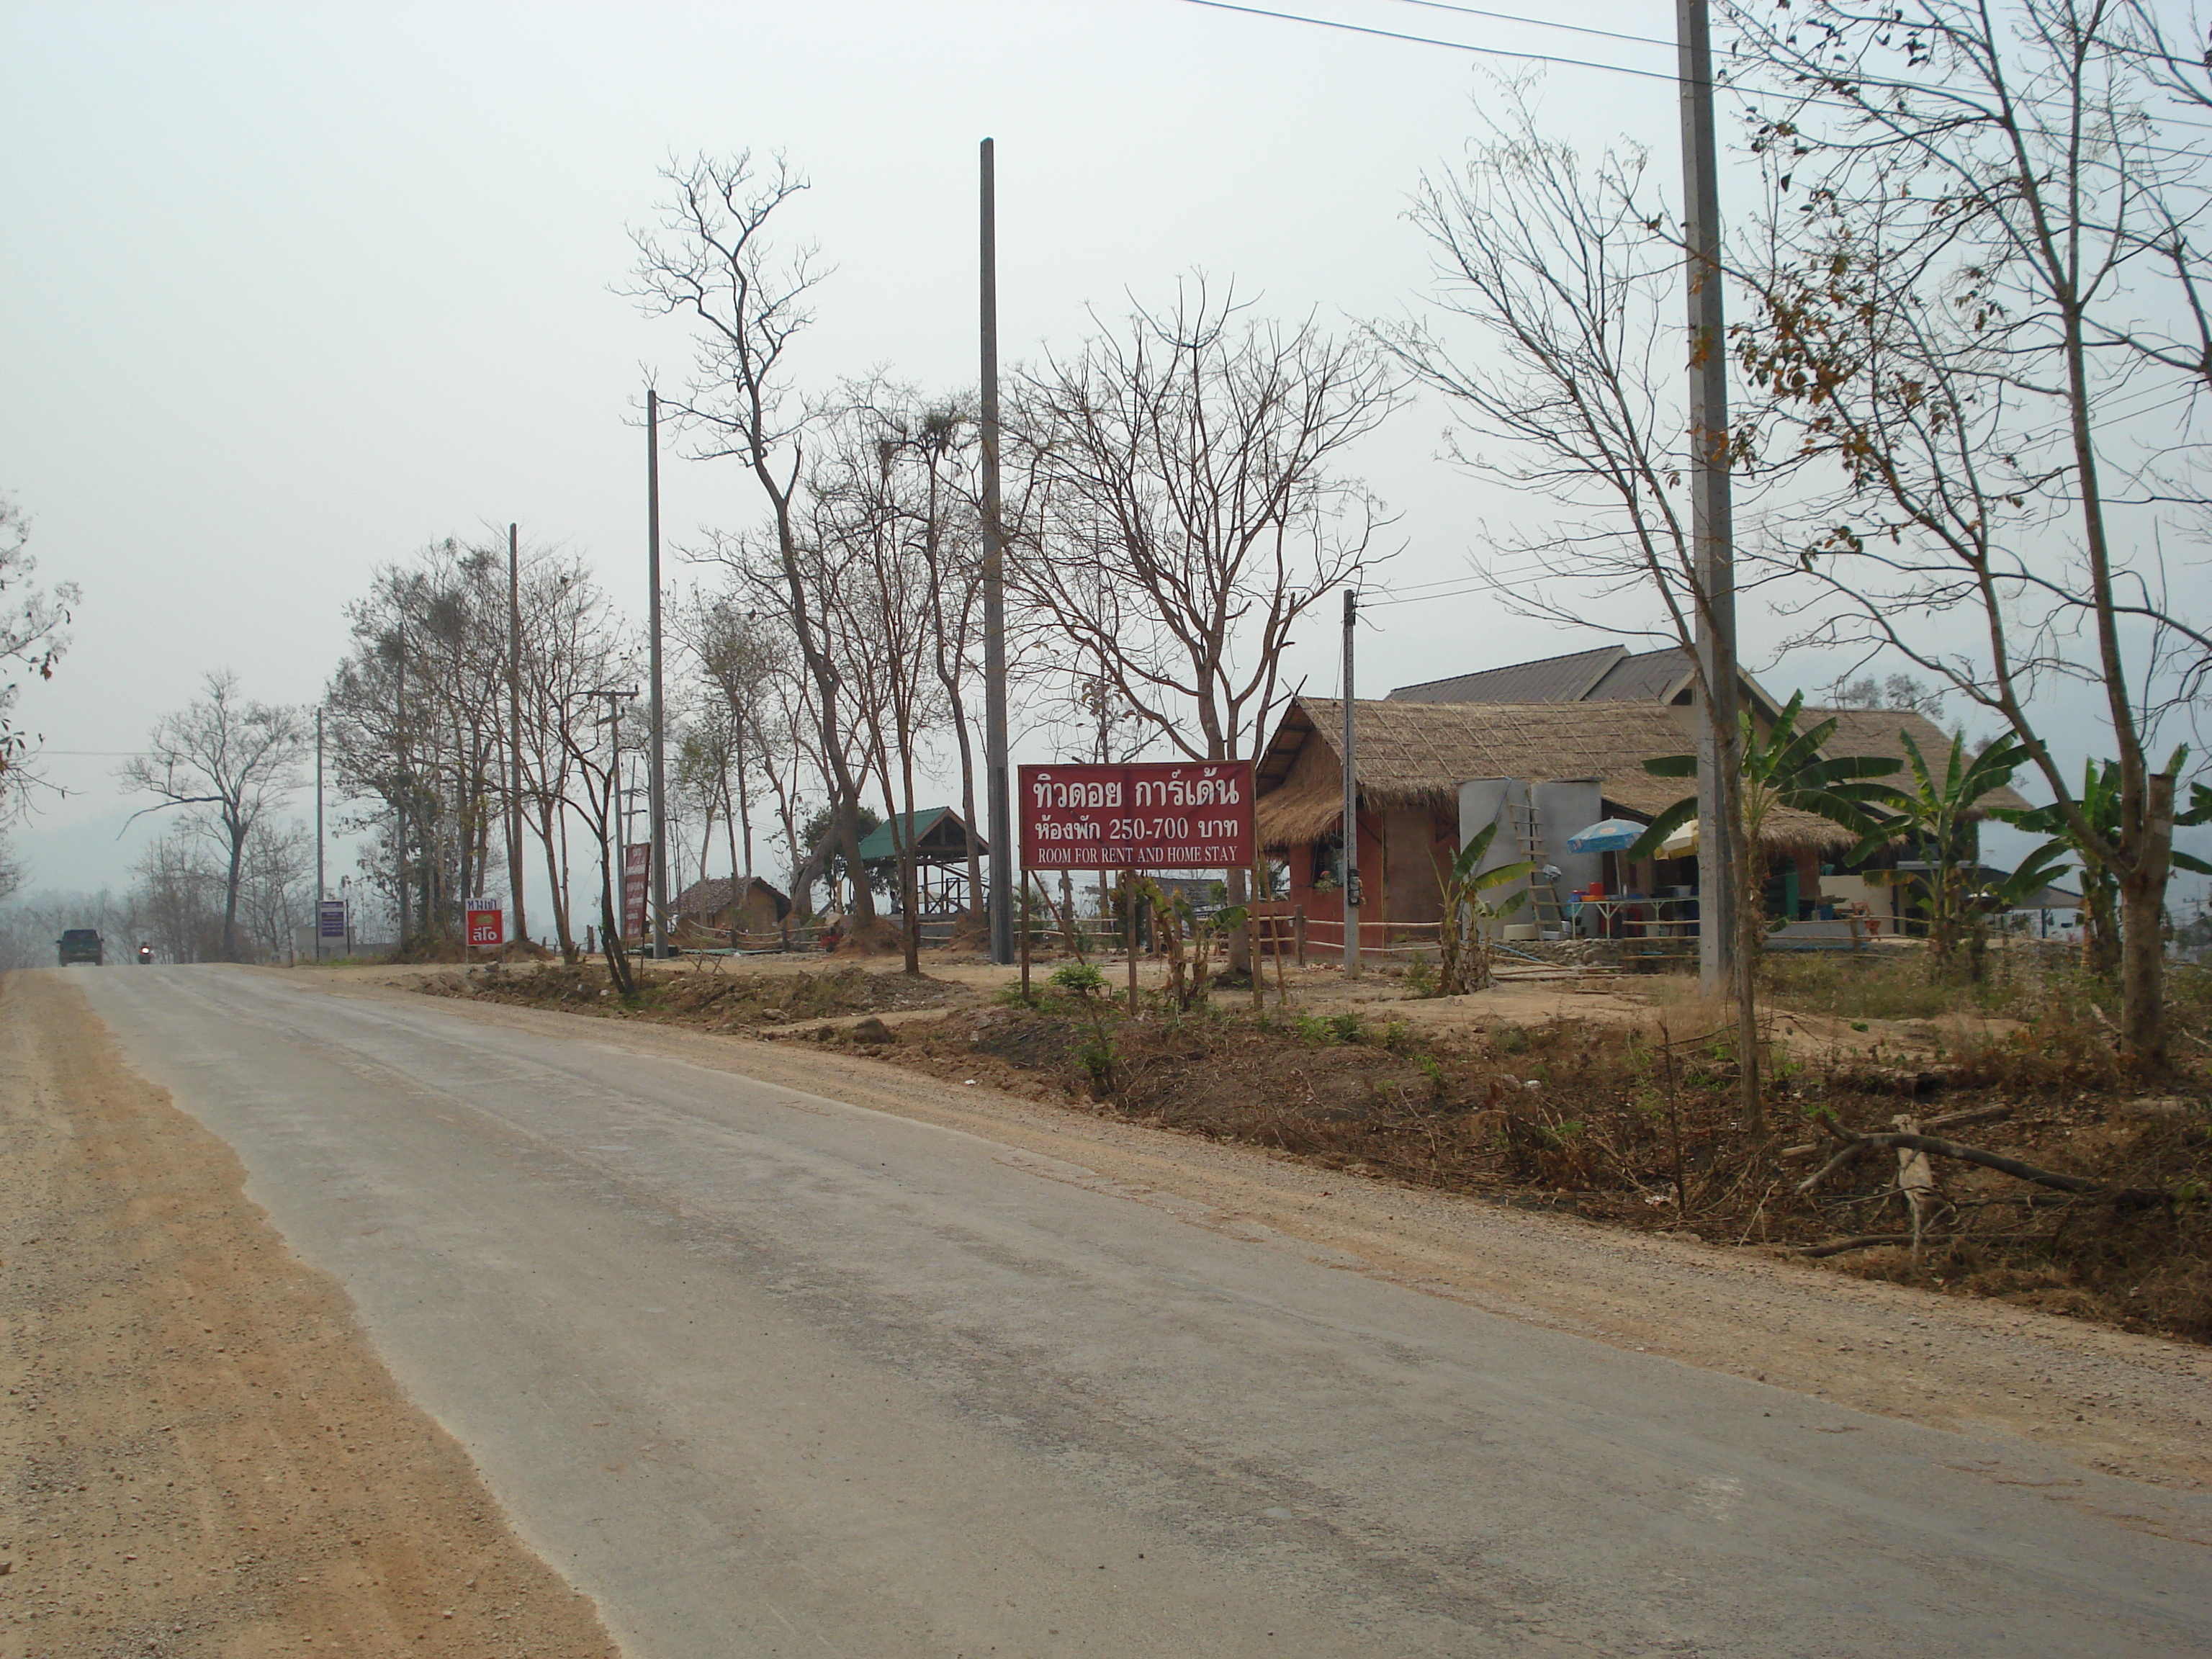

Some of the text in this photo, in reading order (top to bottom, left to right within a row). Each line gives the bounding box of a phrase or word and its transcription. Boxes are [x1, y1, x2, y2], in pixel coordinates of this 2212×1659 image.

[1033, 767, 1240, 808] ทิวดอย การ์เด้น
[1035, 814, 1238, 840] ห้องพัก 250-700 บาท
[1038, 845, 1238, 863] ROOM FOR RENT AND HOME STAY
